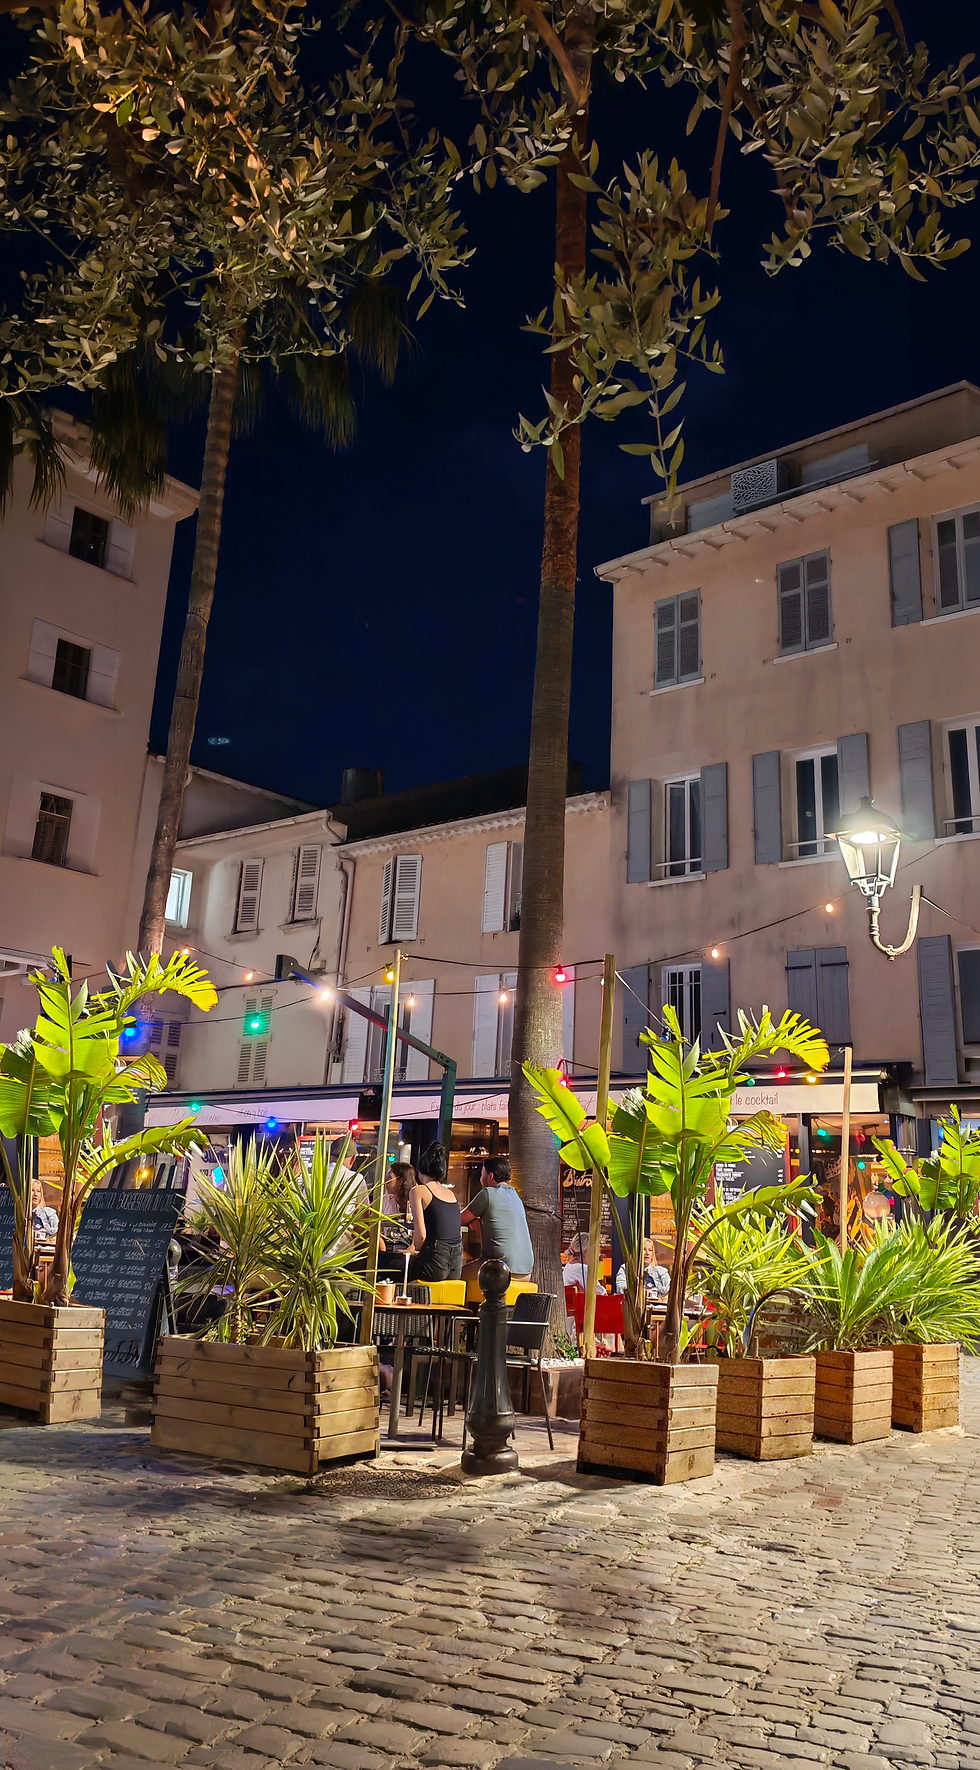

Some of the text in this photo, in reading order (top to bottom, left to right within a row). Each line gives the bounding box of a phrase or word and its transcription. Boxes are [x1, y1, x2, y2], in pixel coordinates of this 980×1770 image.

[735, 1092, 779, 1106] le cocktail
[481, 1099, 497, 1114] plats
